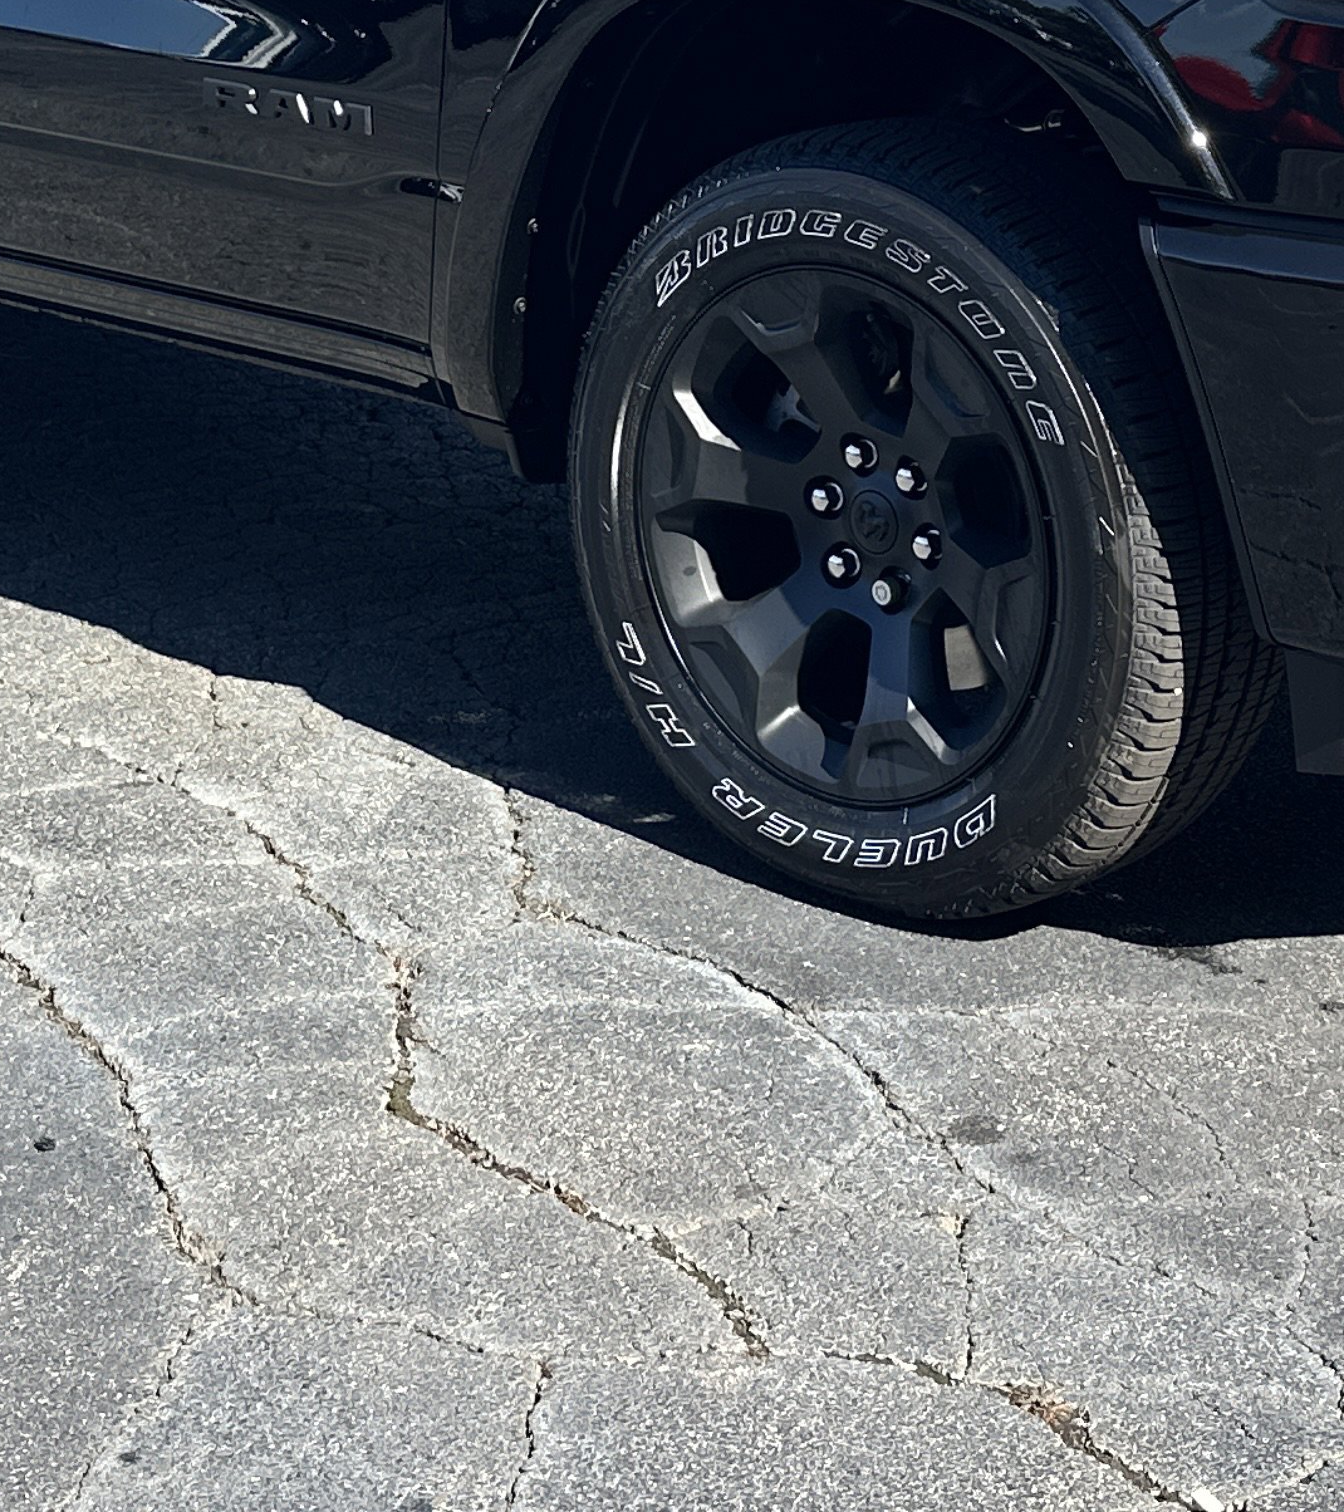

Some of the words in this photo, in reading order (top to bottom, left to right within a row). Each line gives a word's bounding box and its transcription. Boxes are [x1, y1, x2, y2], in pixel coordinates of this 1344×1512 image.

[203, 77, 376, 136] RAM
[655, 207, 1065, 447] BRIDGESTONE
[622, 621, 696, 749] H/L
[710, 776, 998, 869] DUELER
